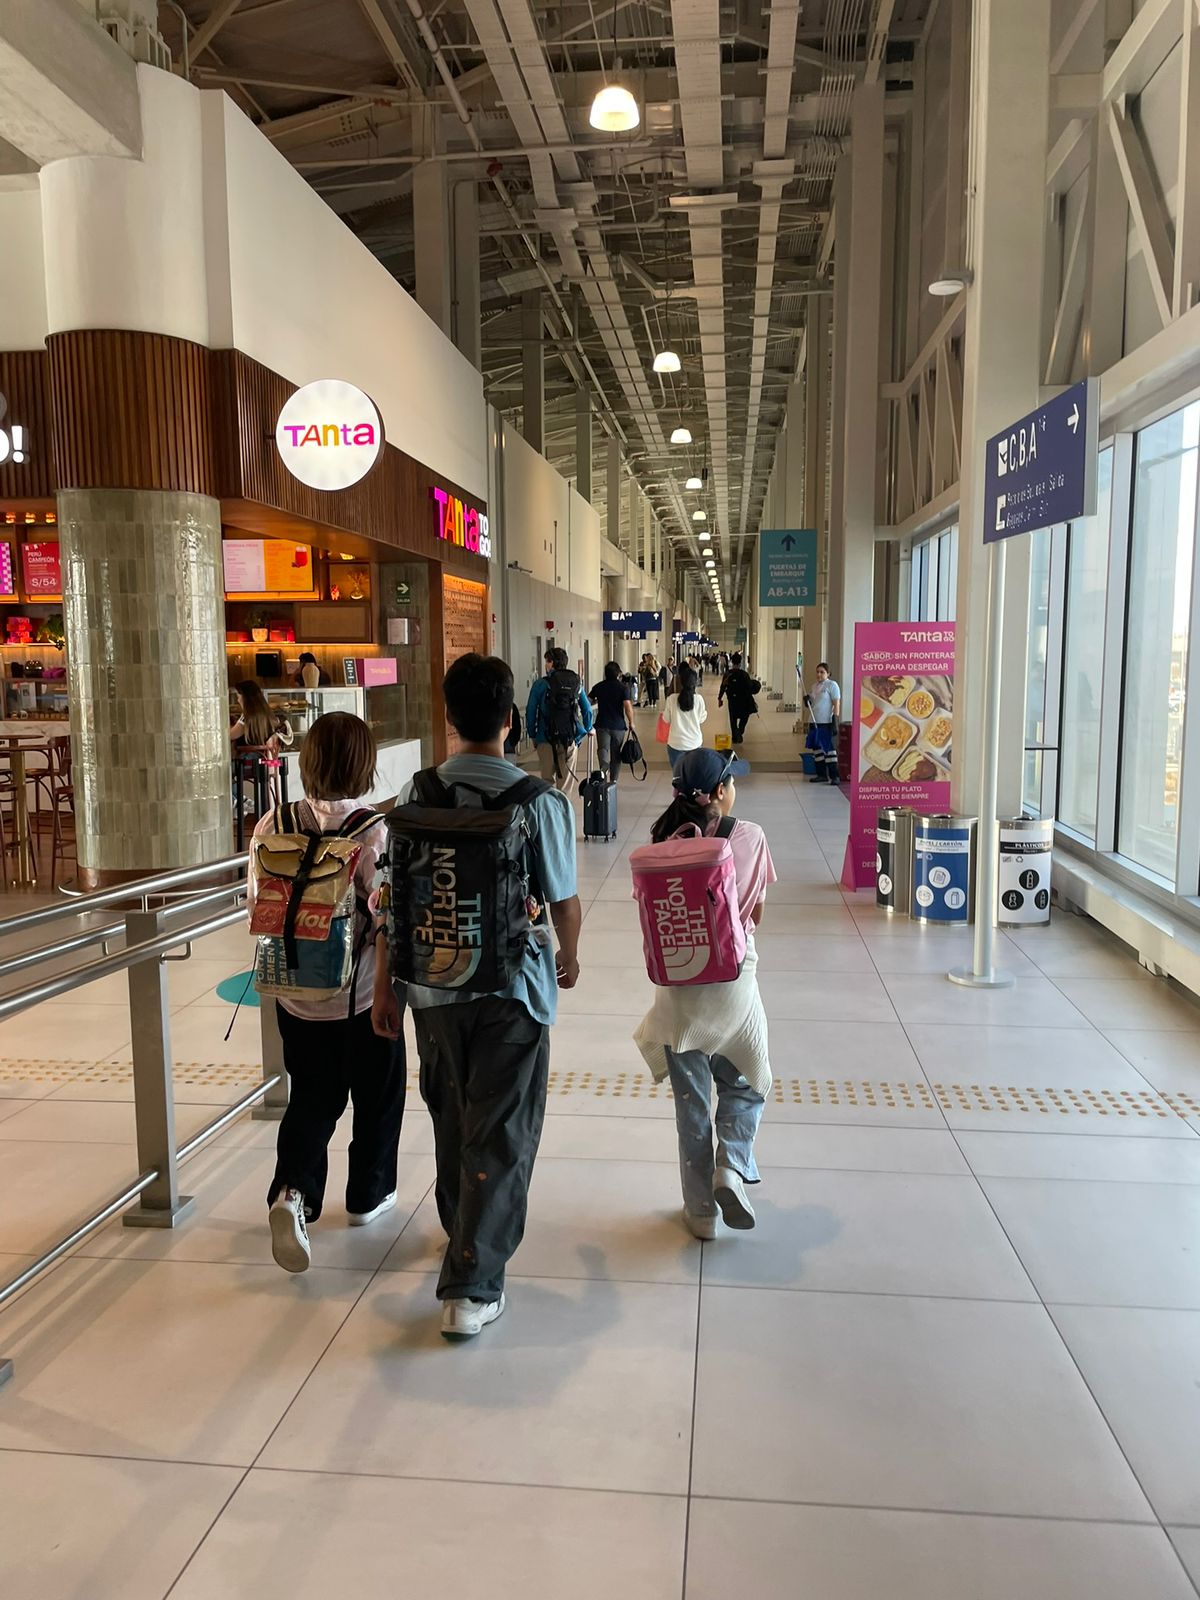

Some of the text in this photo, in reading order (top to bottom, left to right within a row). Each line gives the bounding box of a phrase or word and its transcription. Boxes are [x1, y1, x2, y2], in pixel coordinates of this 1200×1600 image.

[283, 423, 375, 447] TAnta
[434, 486, 489, 553] TAnta TO
[31, 577, 57, 587] S/54
[767, 586, 808, 597] A8-A13
[433, 847, 457, 947] NORTH
[458, 893, 482, 946] THE
[666, 877, 693, 946] NORTH
[653, 899, 677, 947] FACE
[688, 905, 710, 945] THE
